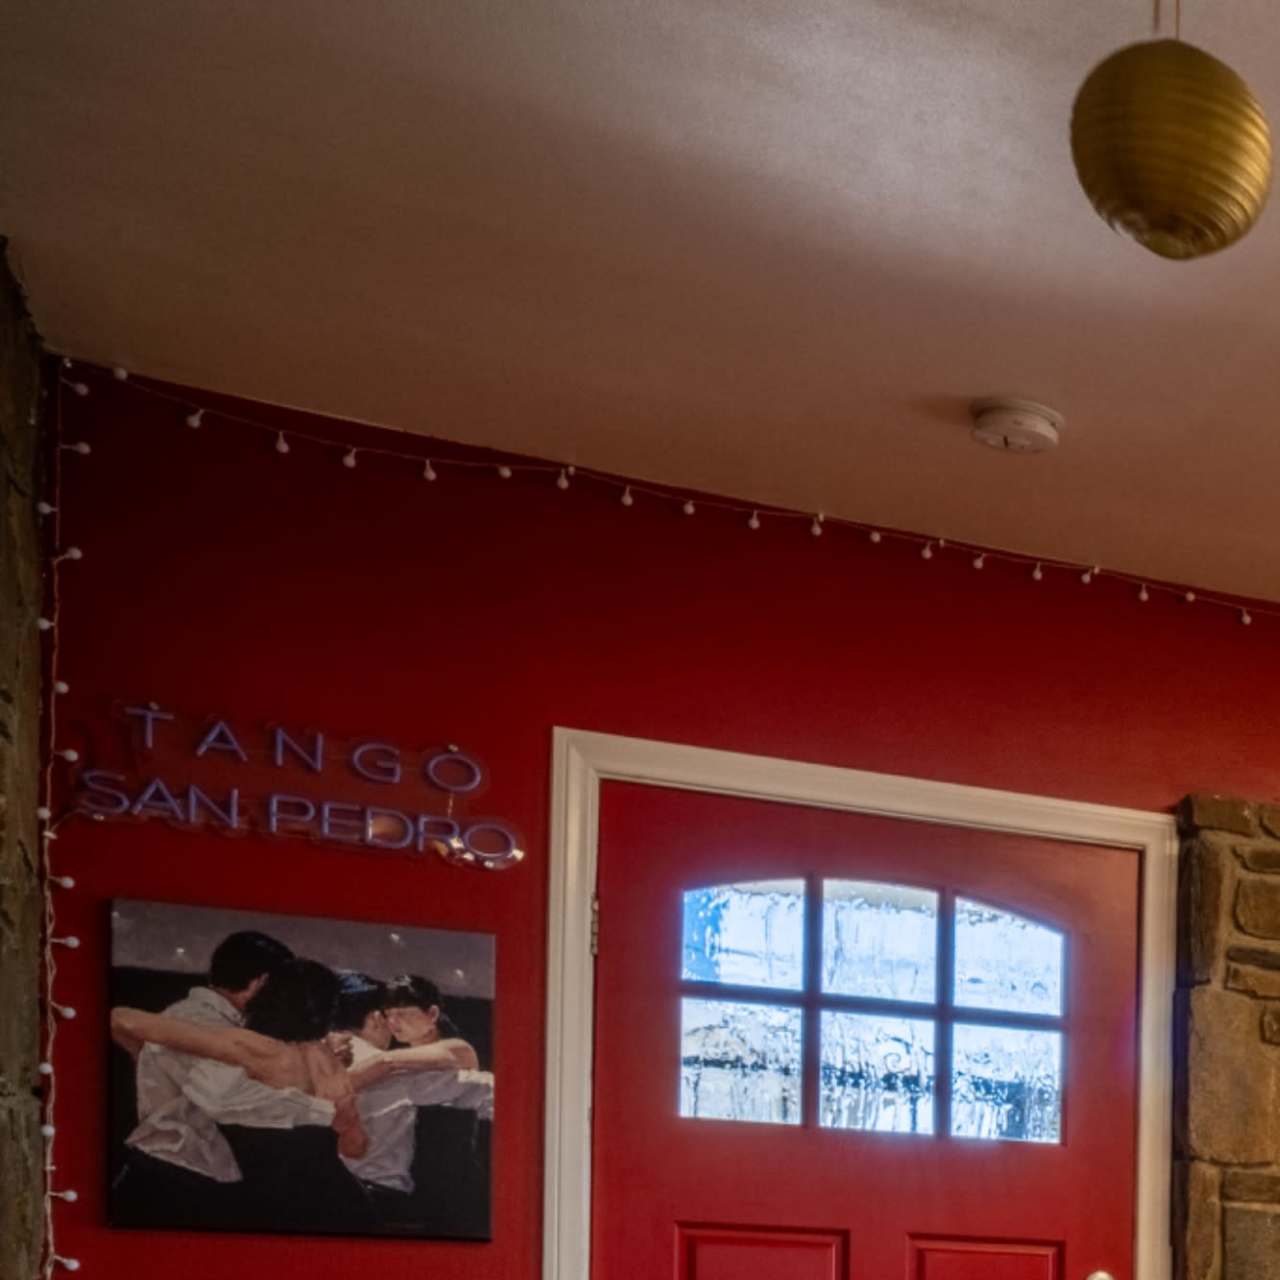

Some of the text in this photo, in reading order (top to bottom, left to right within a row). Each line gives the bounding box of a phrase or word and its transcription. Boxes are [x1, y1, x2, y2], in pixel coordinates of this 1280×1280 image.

[125, 706, 482, 792] TANGO
[82, 769, 517, 859] SAN PEDRO
